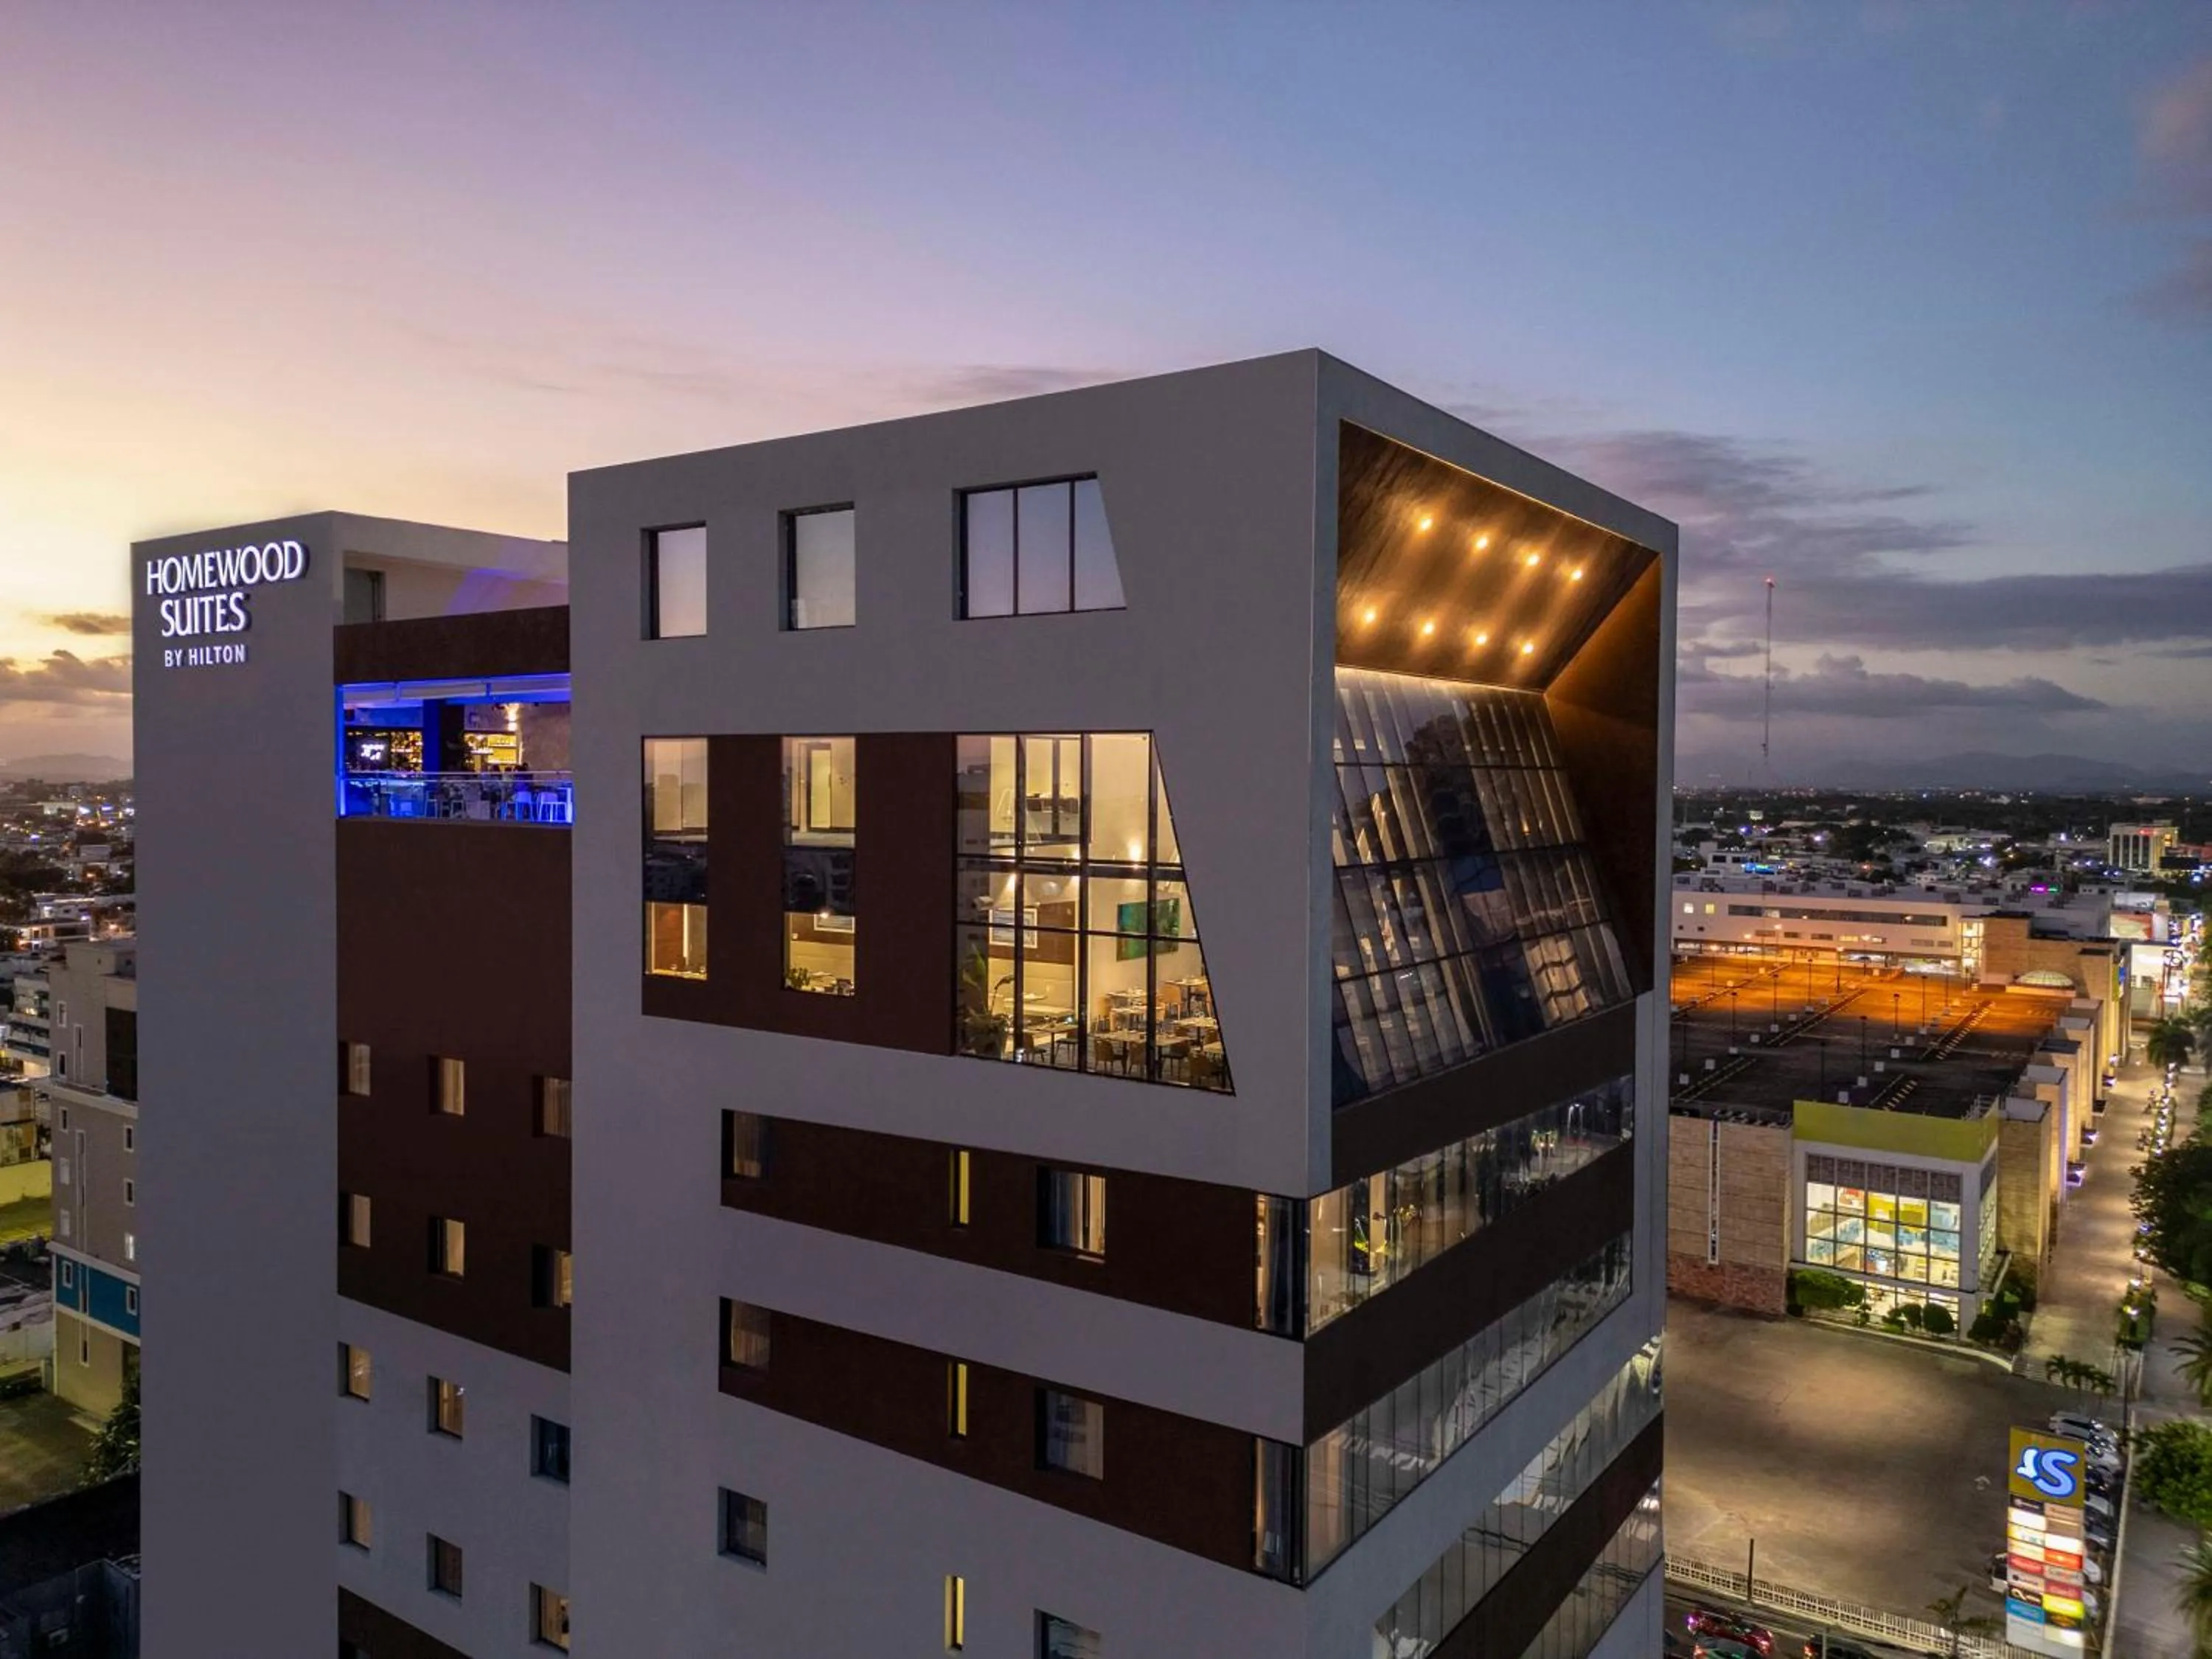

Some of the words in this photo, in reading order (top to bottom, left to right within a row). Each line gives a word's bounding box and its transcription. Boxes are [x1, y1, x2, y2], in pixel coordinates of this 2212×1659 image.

[147, 541, 304, 595] HOMEWOOD
[160, 592, 246, 637] SUITES
[164, 649, 183, 667] BY
[189, 644, 246, 666] HILTON
